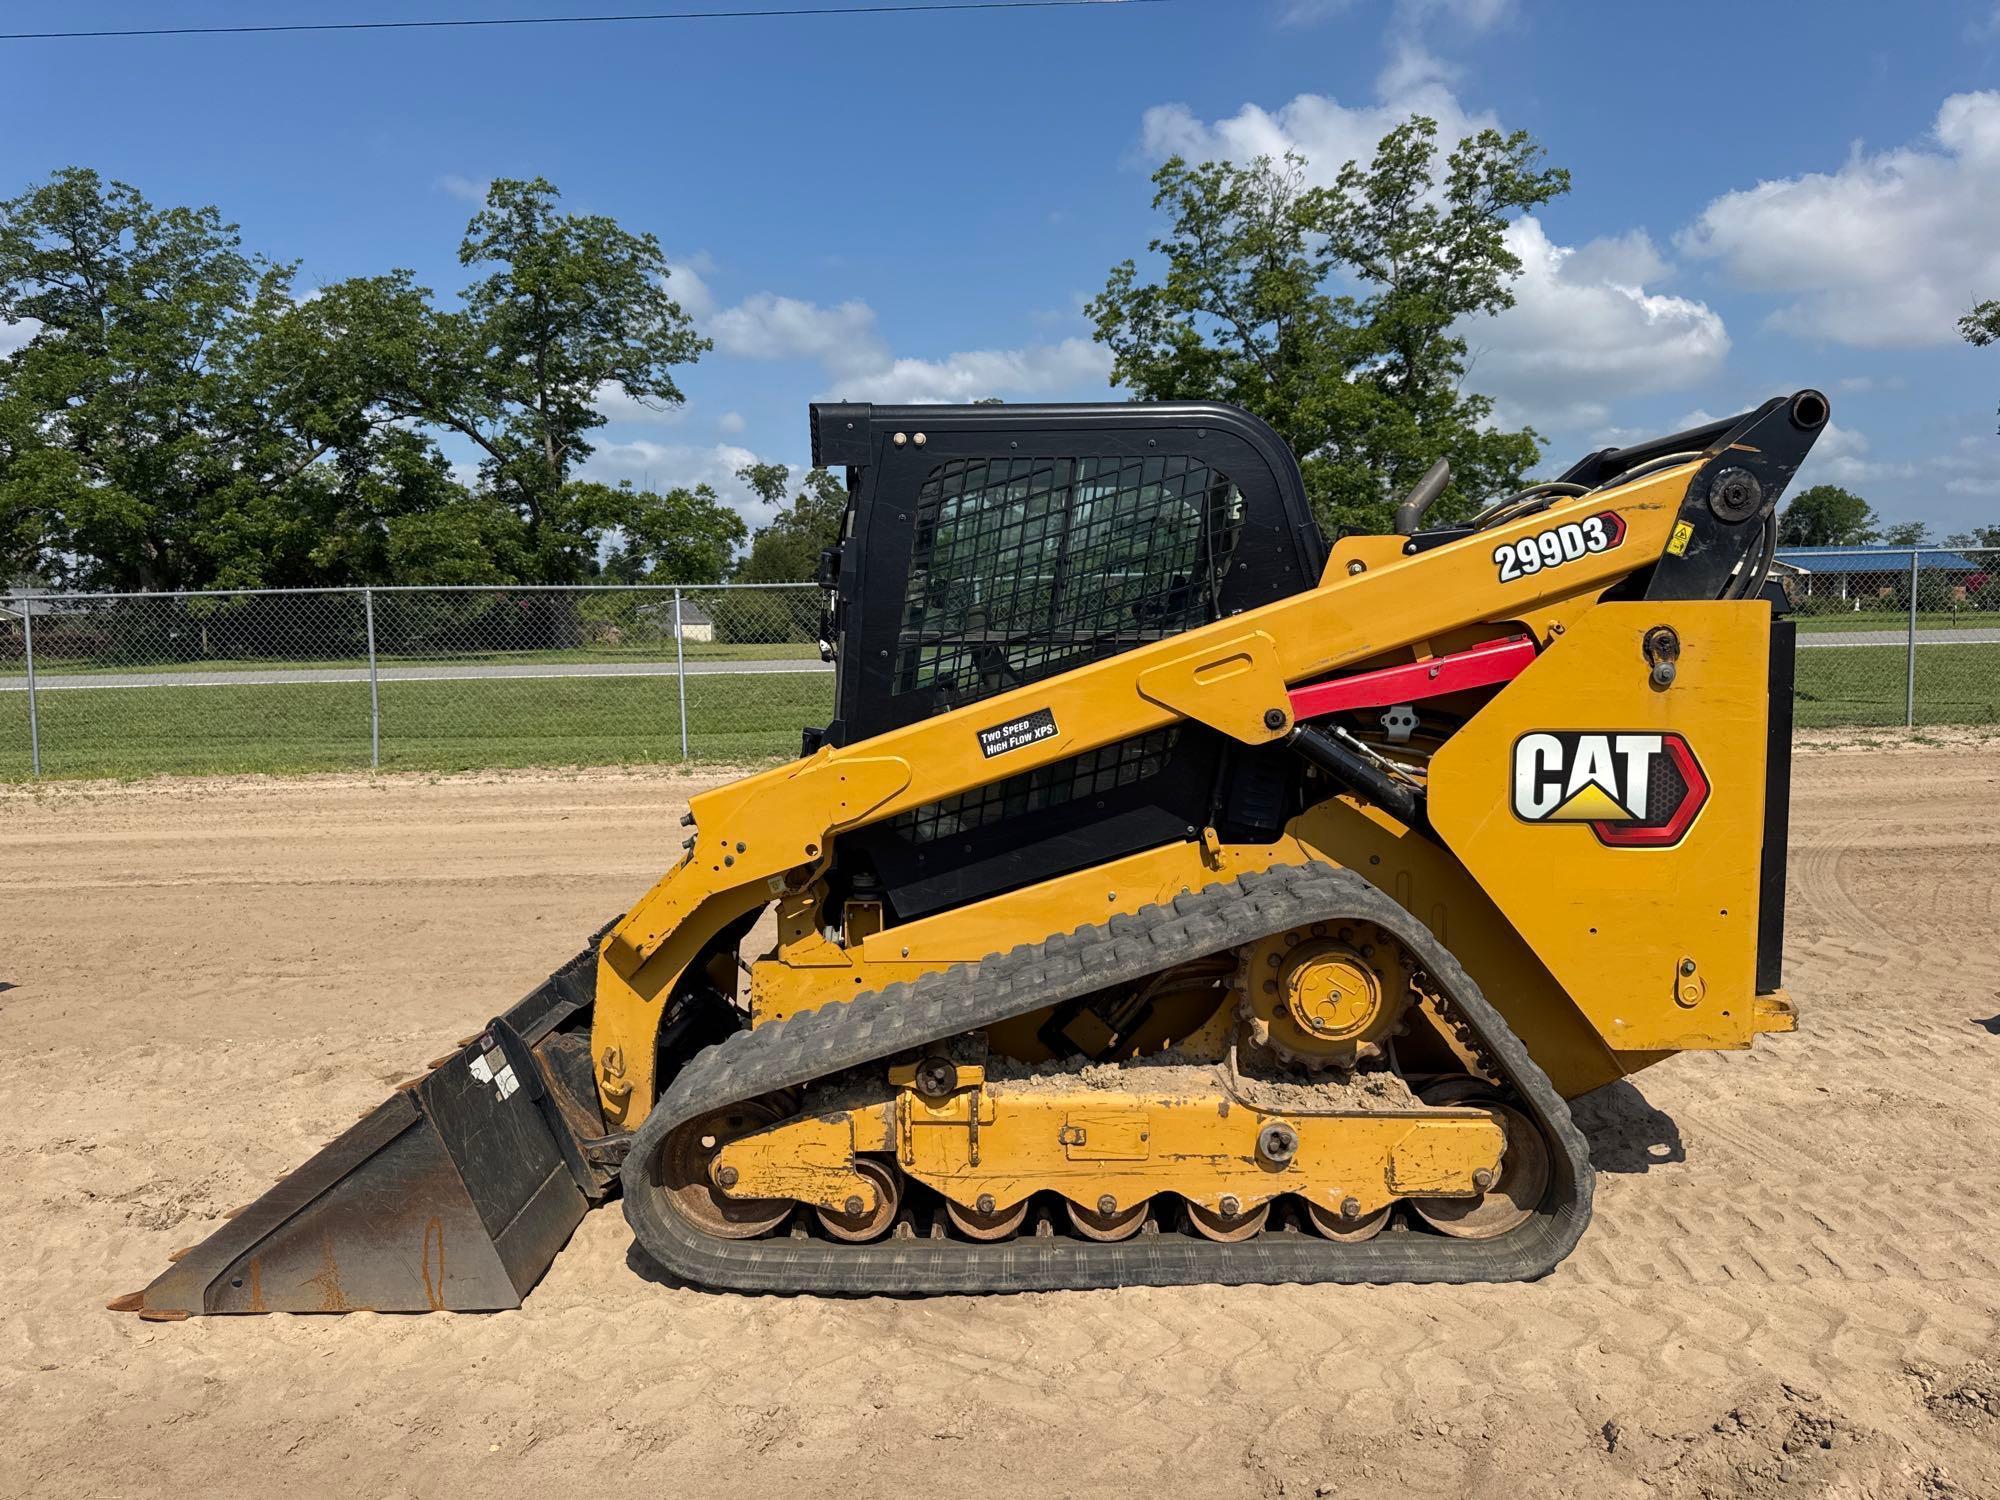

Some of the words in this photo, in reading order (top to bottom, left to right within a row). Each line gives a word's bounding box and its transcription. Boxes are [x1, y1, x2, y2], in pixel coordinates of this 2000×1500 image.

[1494, 517, 1608, 582] 299D3
[981, 730, 1000, 743] TWO
[1002, 720, 1029, 736] SPEED
[986, 741, 1007, 755] HIGH
[1009, 732, 1032, 747] FLOW
[1034, 724, 1053, 738] XPS
[1515, 733, 1662, 819] CAT
